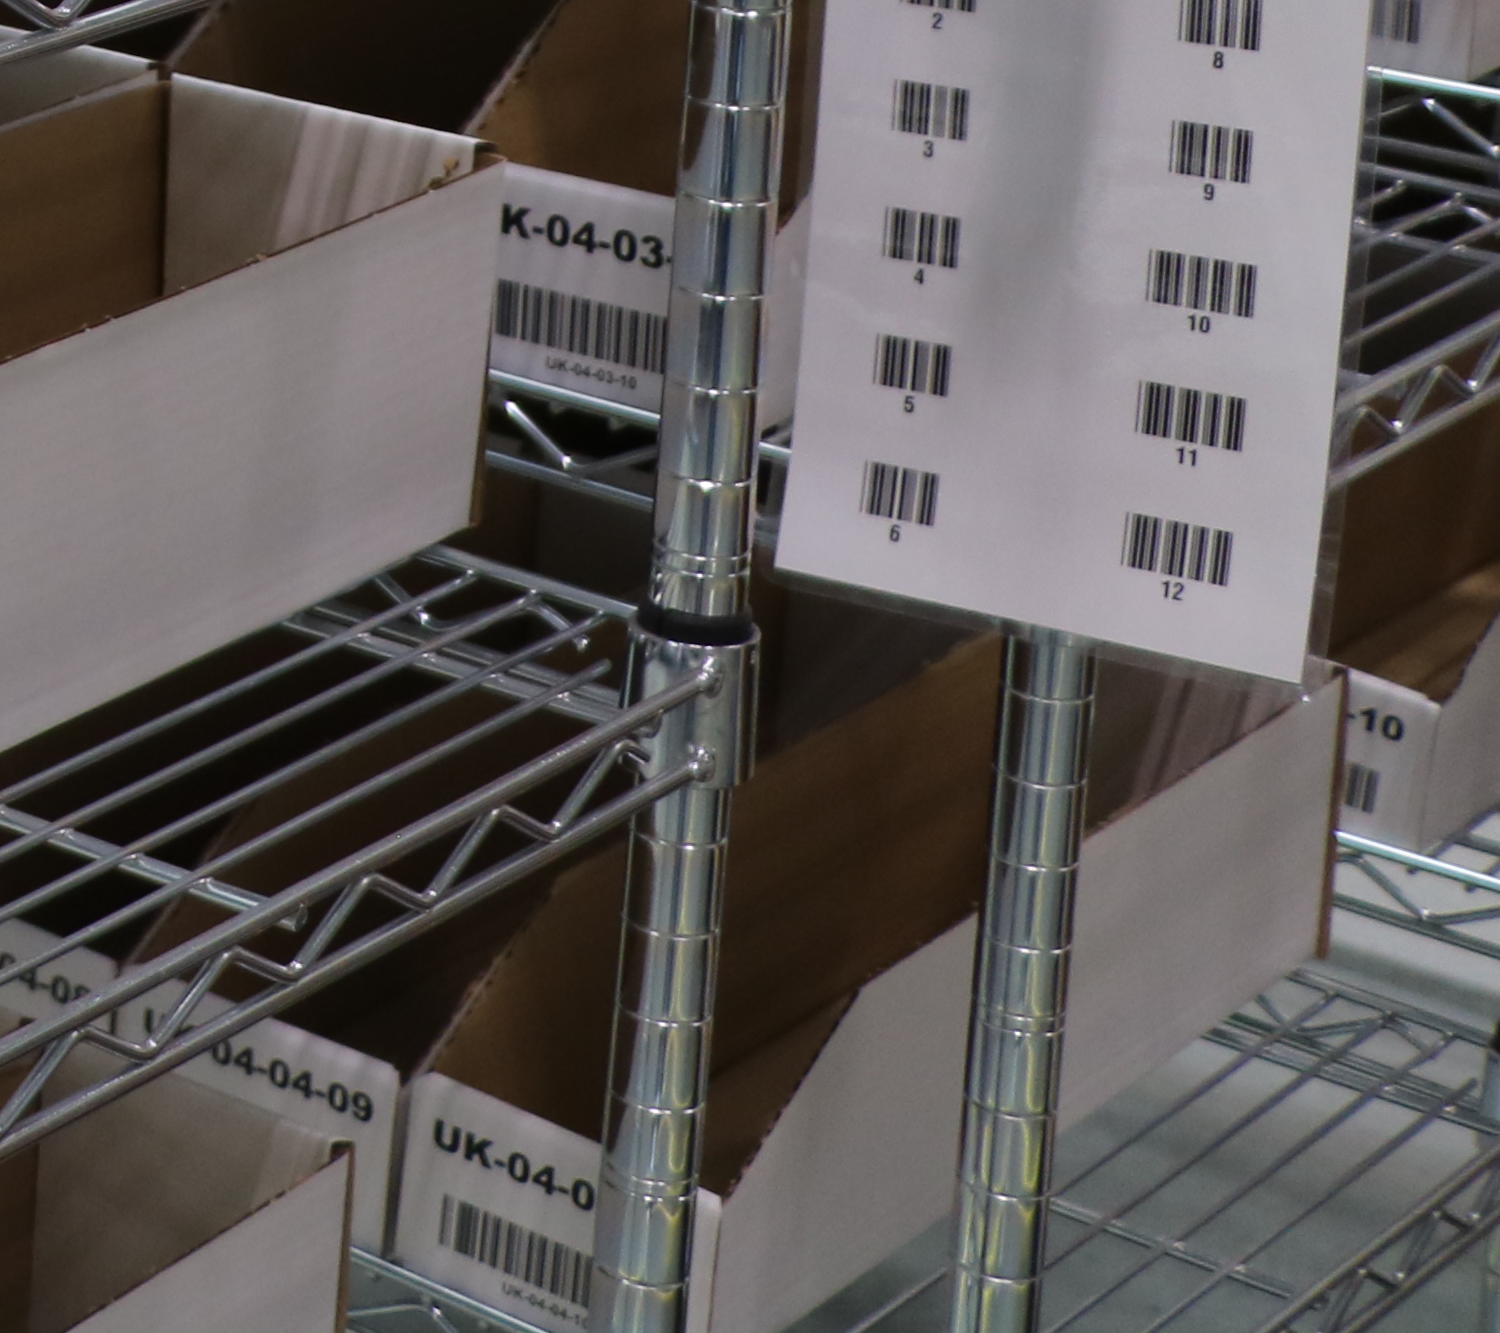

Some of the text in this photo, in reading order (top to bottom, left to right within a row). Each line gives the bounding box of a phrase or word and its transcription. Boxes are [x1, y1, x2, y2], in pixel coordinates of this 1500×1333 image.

[931, 11, 944, 30] 2
[1212, 51, 1225, 70] 8
[922, 140, 934, 159] 3
[1203, 183, 1215, 202] 9
[913, 268, 925, 285] 4
[1187, 314, 1211, 334] 10
[903, 395, 915, 414] 5
[1176, 446, 1198, 467] 11
[889, 524, 901, 543] 6
[1161, 580, 1185, 602] 12
[434, 1118, 595, 1211] UK-04-0
